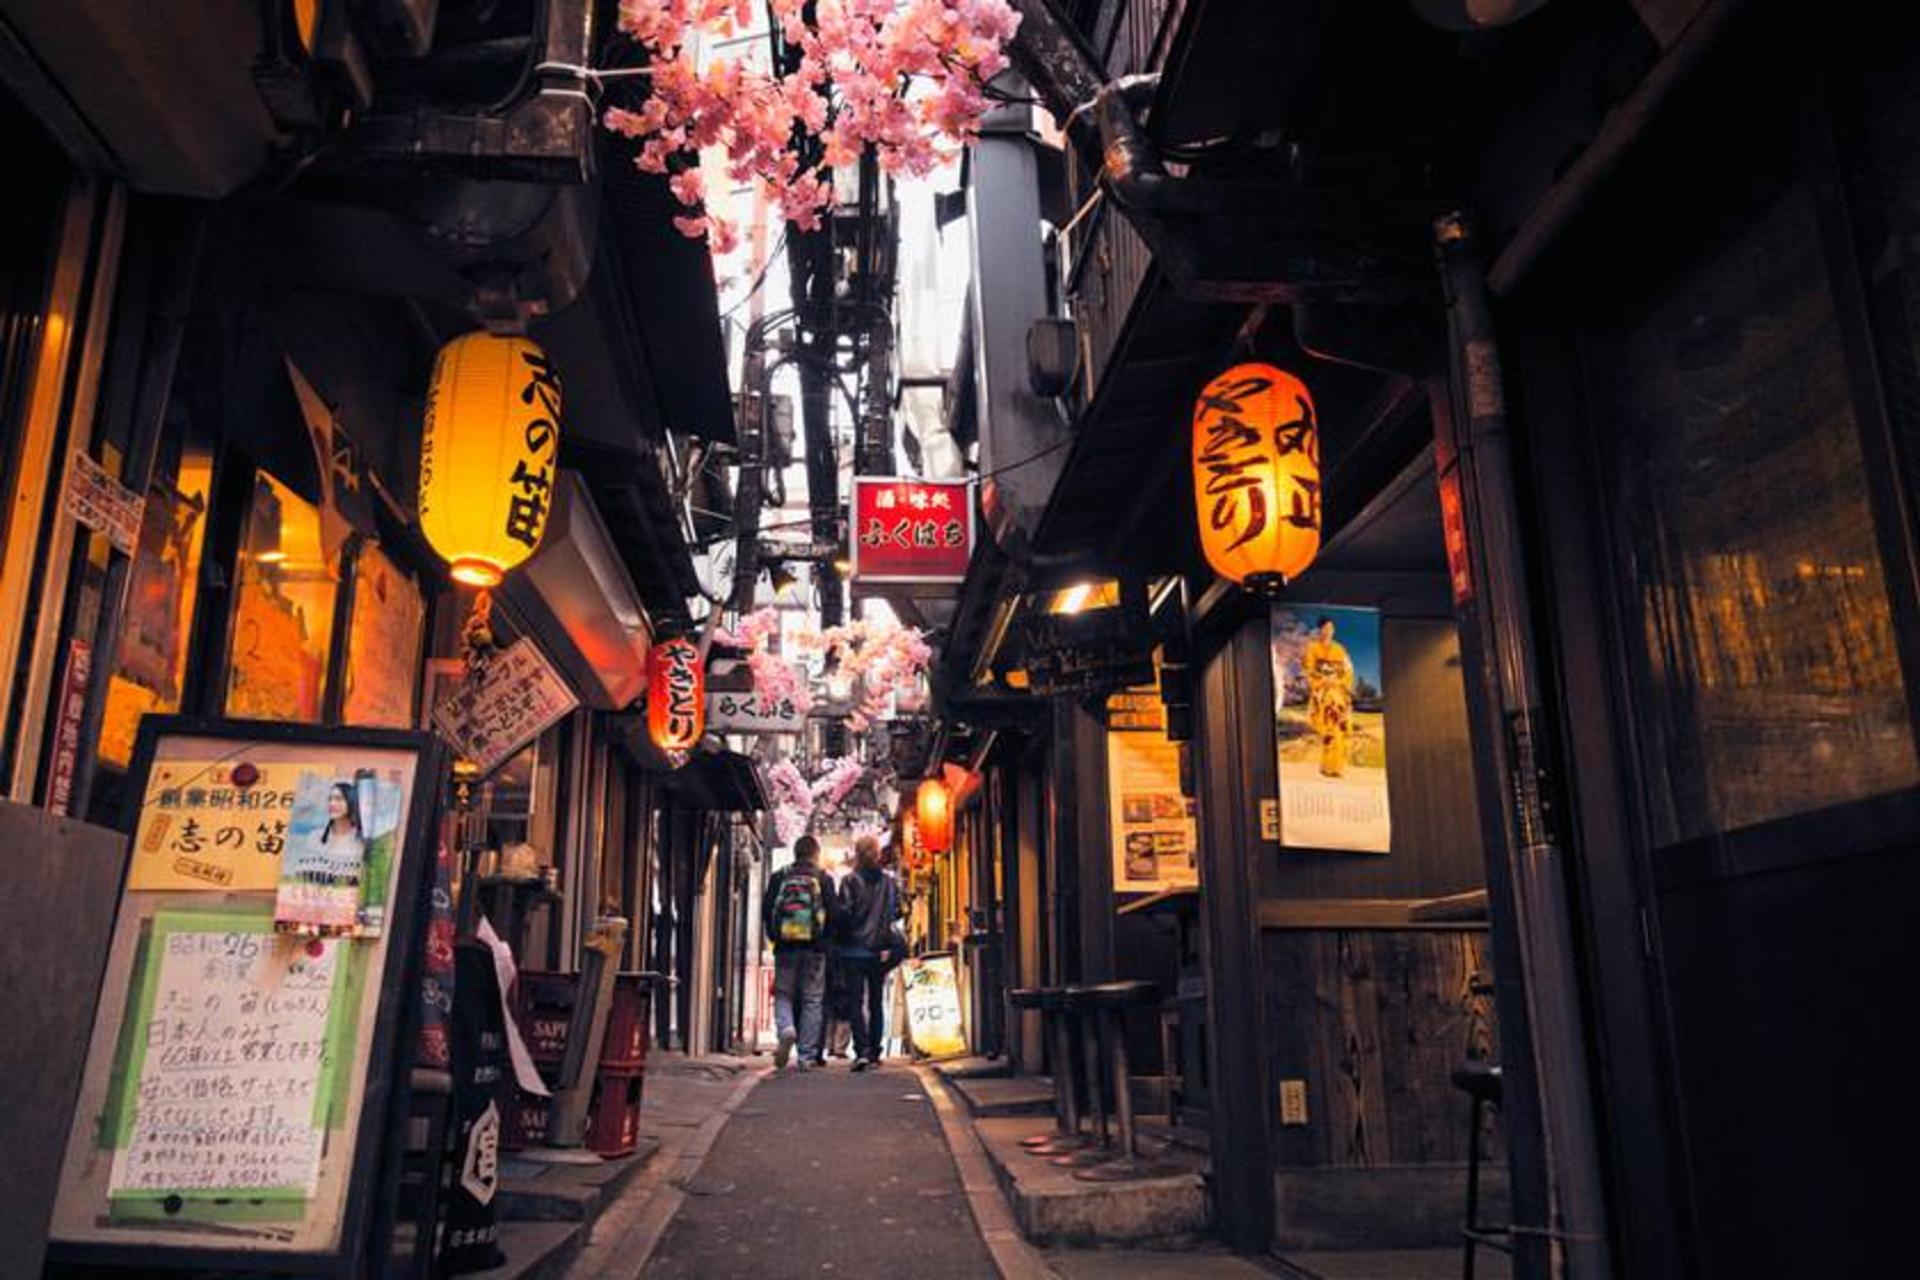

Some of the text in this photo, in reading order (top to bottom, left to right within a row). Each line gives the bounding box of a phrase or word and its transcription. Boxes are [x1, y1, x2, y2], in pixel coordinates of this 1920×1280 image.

[860, 519, 963, 549] ふくはち
[665, 644, 697, 742] やきとり
[171, 818, 286, 857] 志の笛
